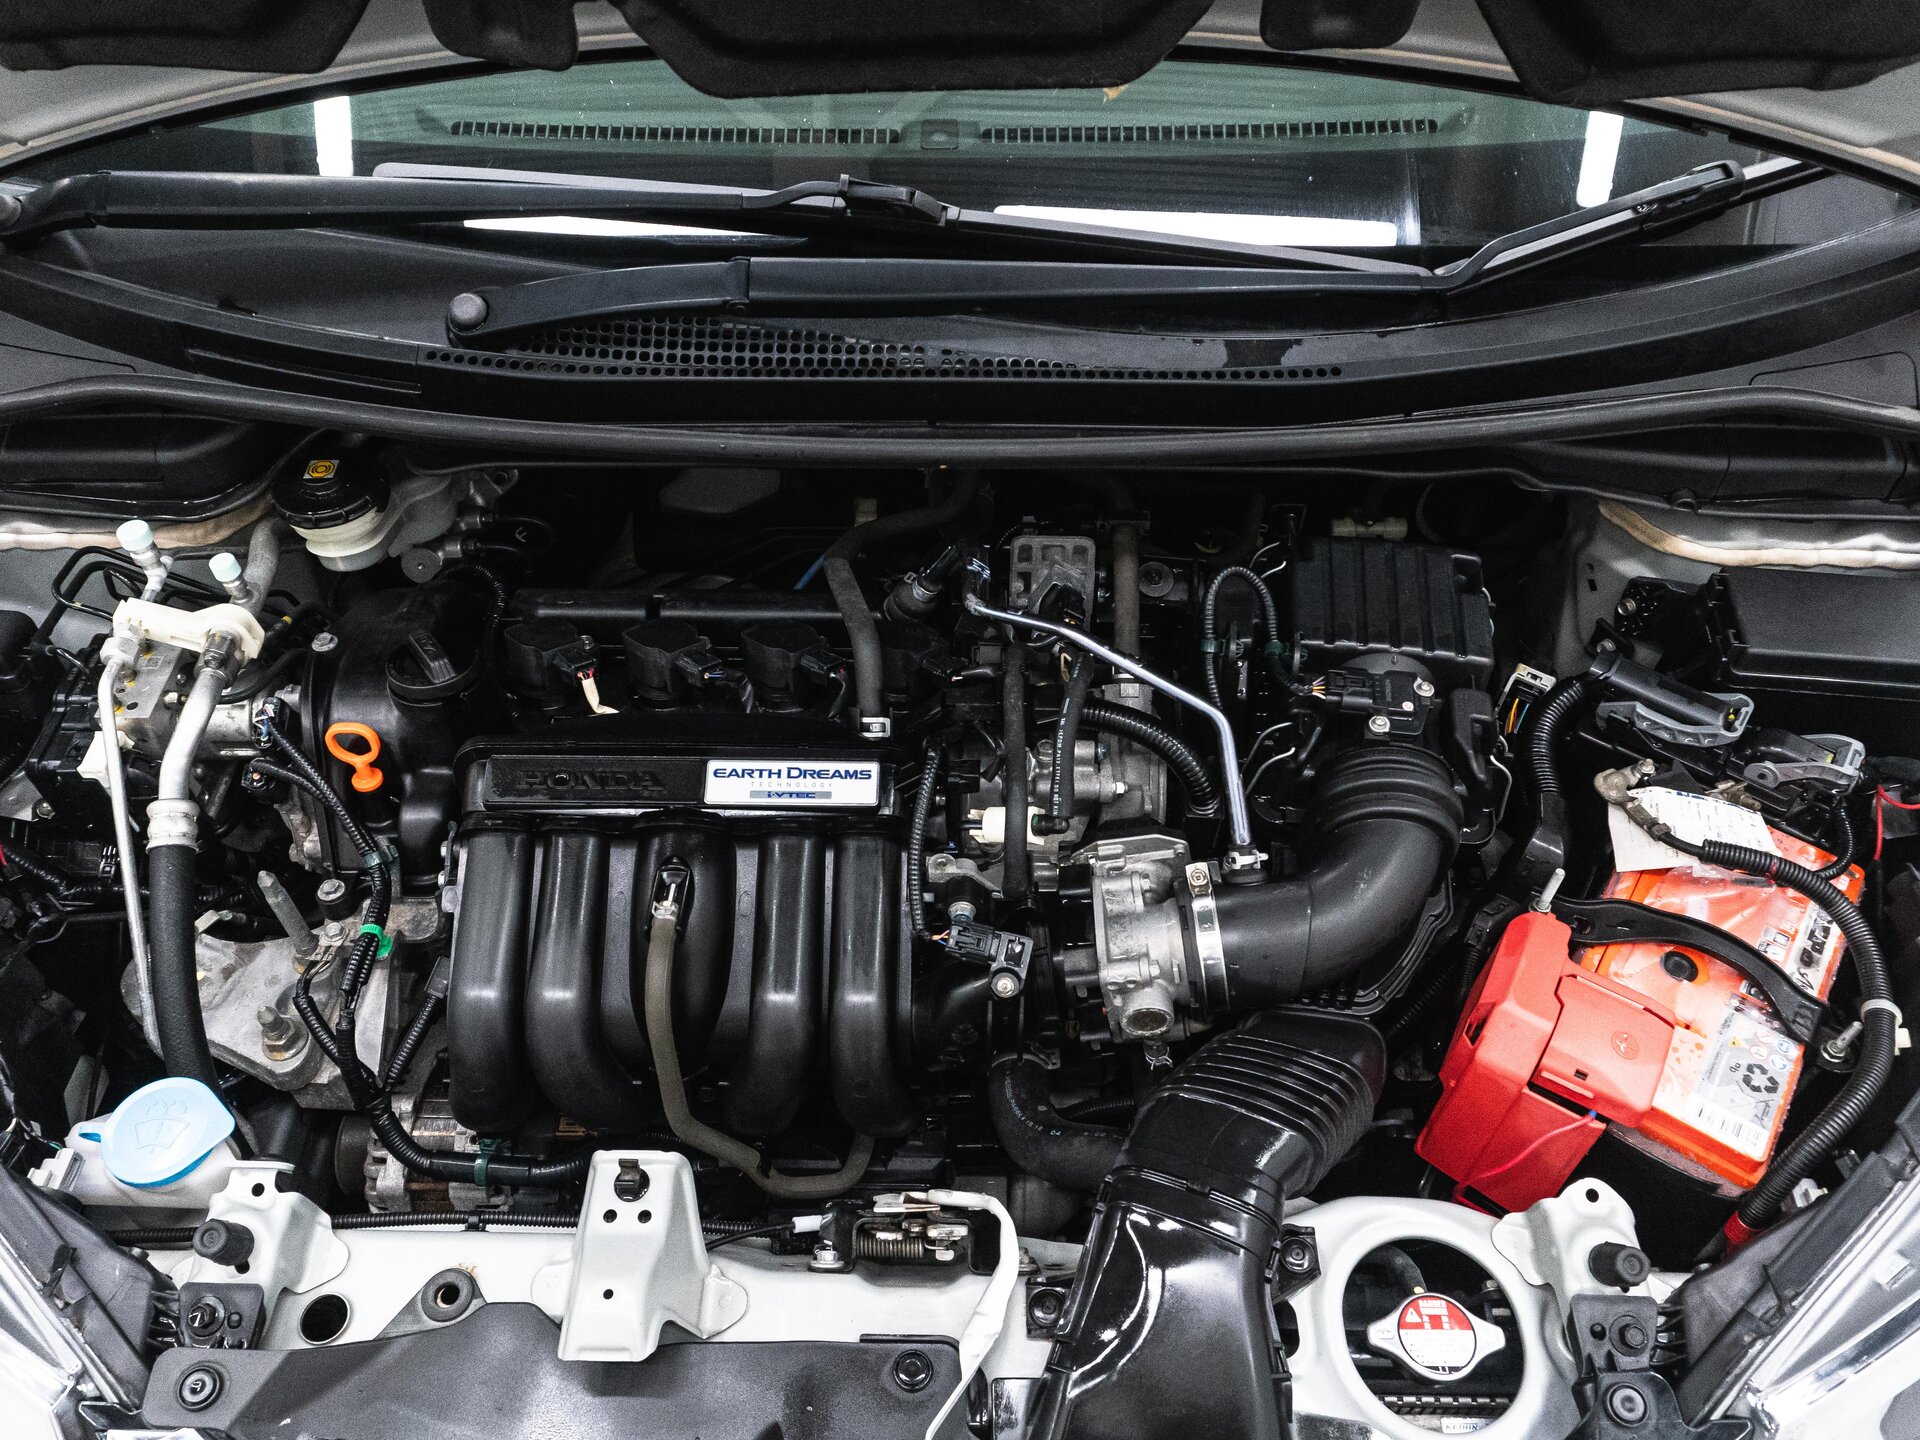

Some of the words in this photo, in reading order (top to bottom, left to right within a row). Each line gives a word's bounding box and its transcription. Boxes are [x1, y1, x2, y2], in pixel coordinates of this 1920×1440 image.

[515, 769, 665, 790] HONDA
[713, 768, 782, 779] EARTH
[786, 766, 872, 780] DREAMS
